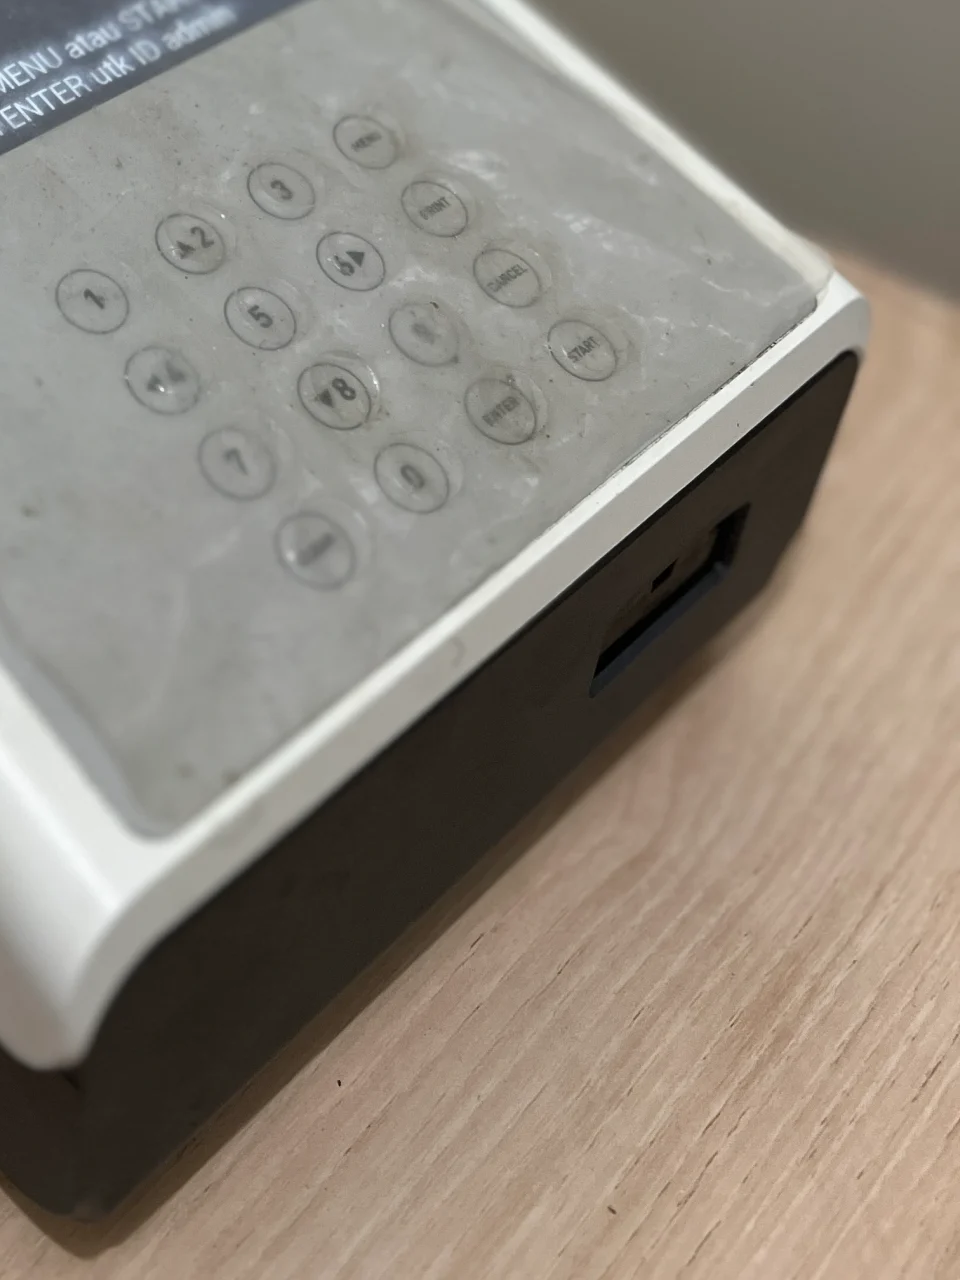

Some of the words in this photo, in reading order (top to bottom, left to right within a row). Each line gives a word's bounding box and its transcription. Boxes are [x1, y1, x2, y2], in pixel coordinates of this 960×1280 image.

[64, 20, 122, 61] atau
[90, 52, 135, 86] utk
[128, 38, 162, 67] ID
[271, 180, 293, 201] 3
[190, 226, 214, 248] 2
[83, 287, 106, 310] 1
[247, 306, 273, 329] 5
[567, 336, 601, 363] START
[332, 377, 357, 401] 8
